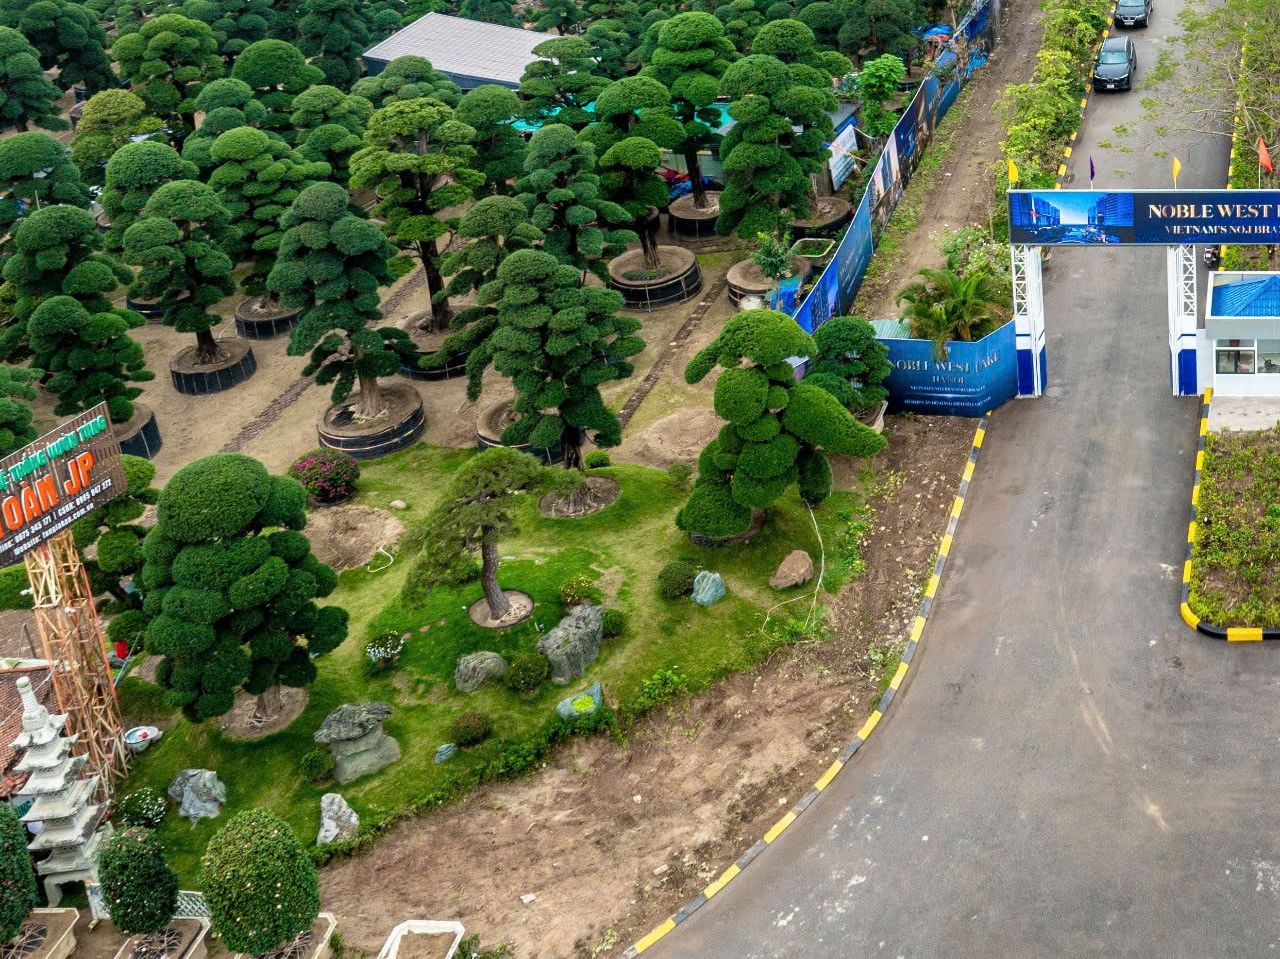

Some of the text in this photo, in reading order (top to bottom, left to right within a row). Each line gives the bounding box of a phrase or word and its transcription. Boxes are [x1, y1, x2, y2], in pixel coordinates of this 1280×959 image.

[1148, 204, 1214, 219] NOBLE
[1216, 204, 1273, 218] WEST
[1165, 225, 1228, 234] VIETNAM'S
[1229, 225, 1252, 234] NO.1
[887, 350, 1001, 373] NOBLE WEST LAKE
[77, 415, 107, 443] TÙNG
[0, 451, 95, 539] OÀN JP
